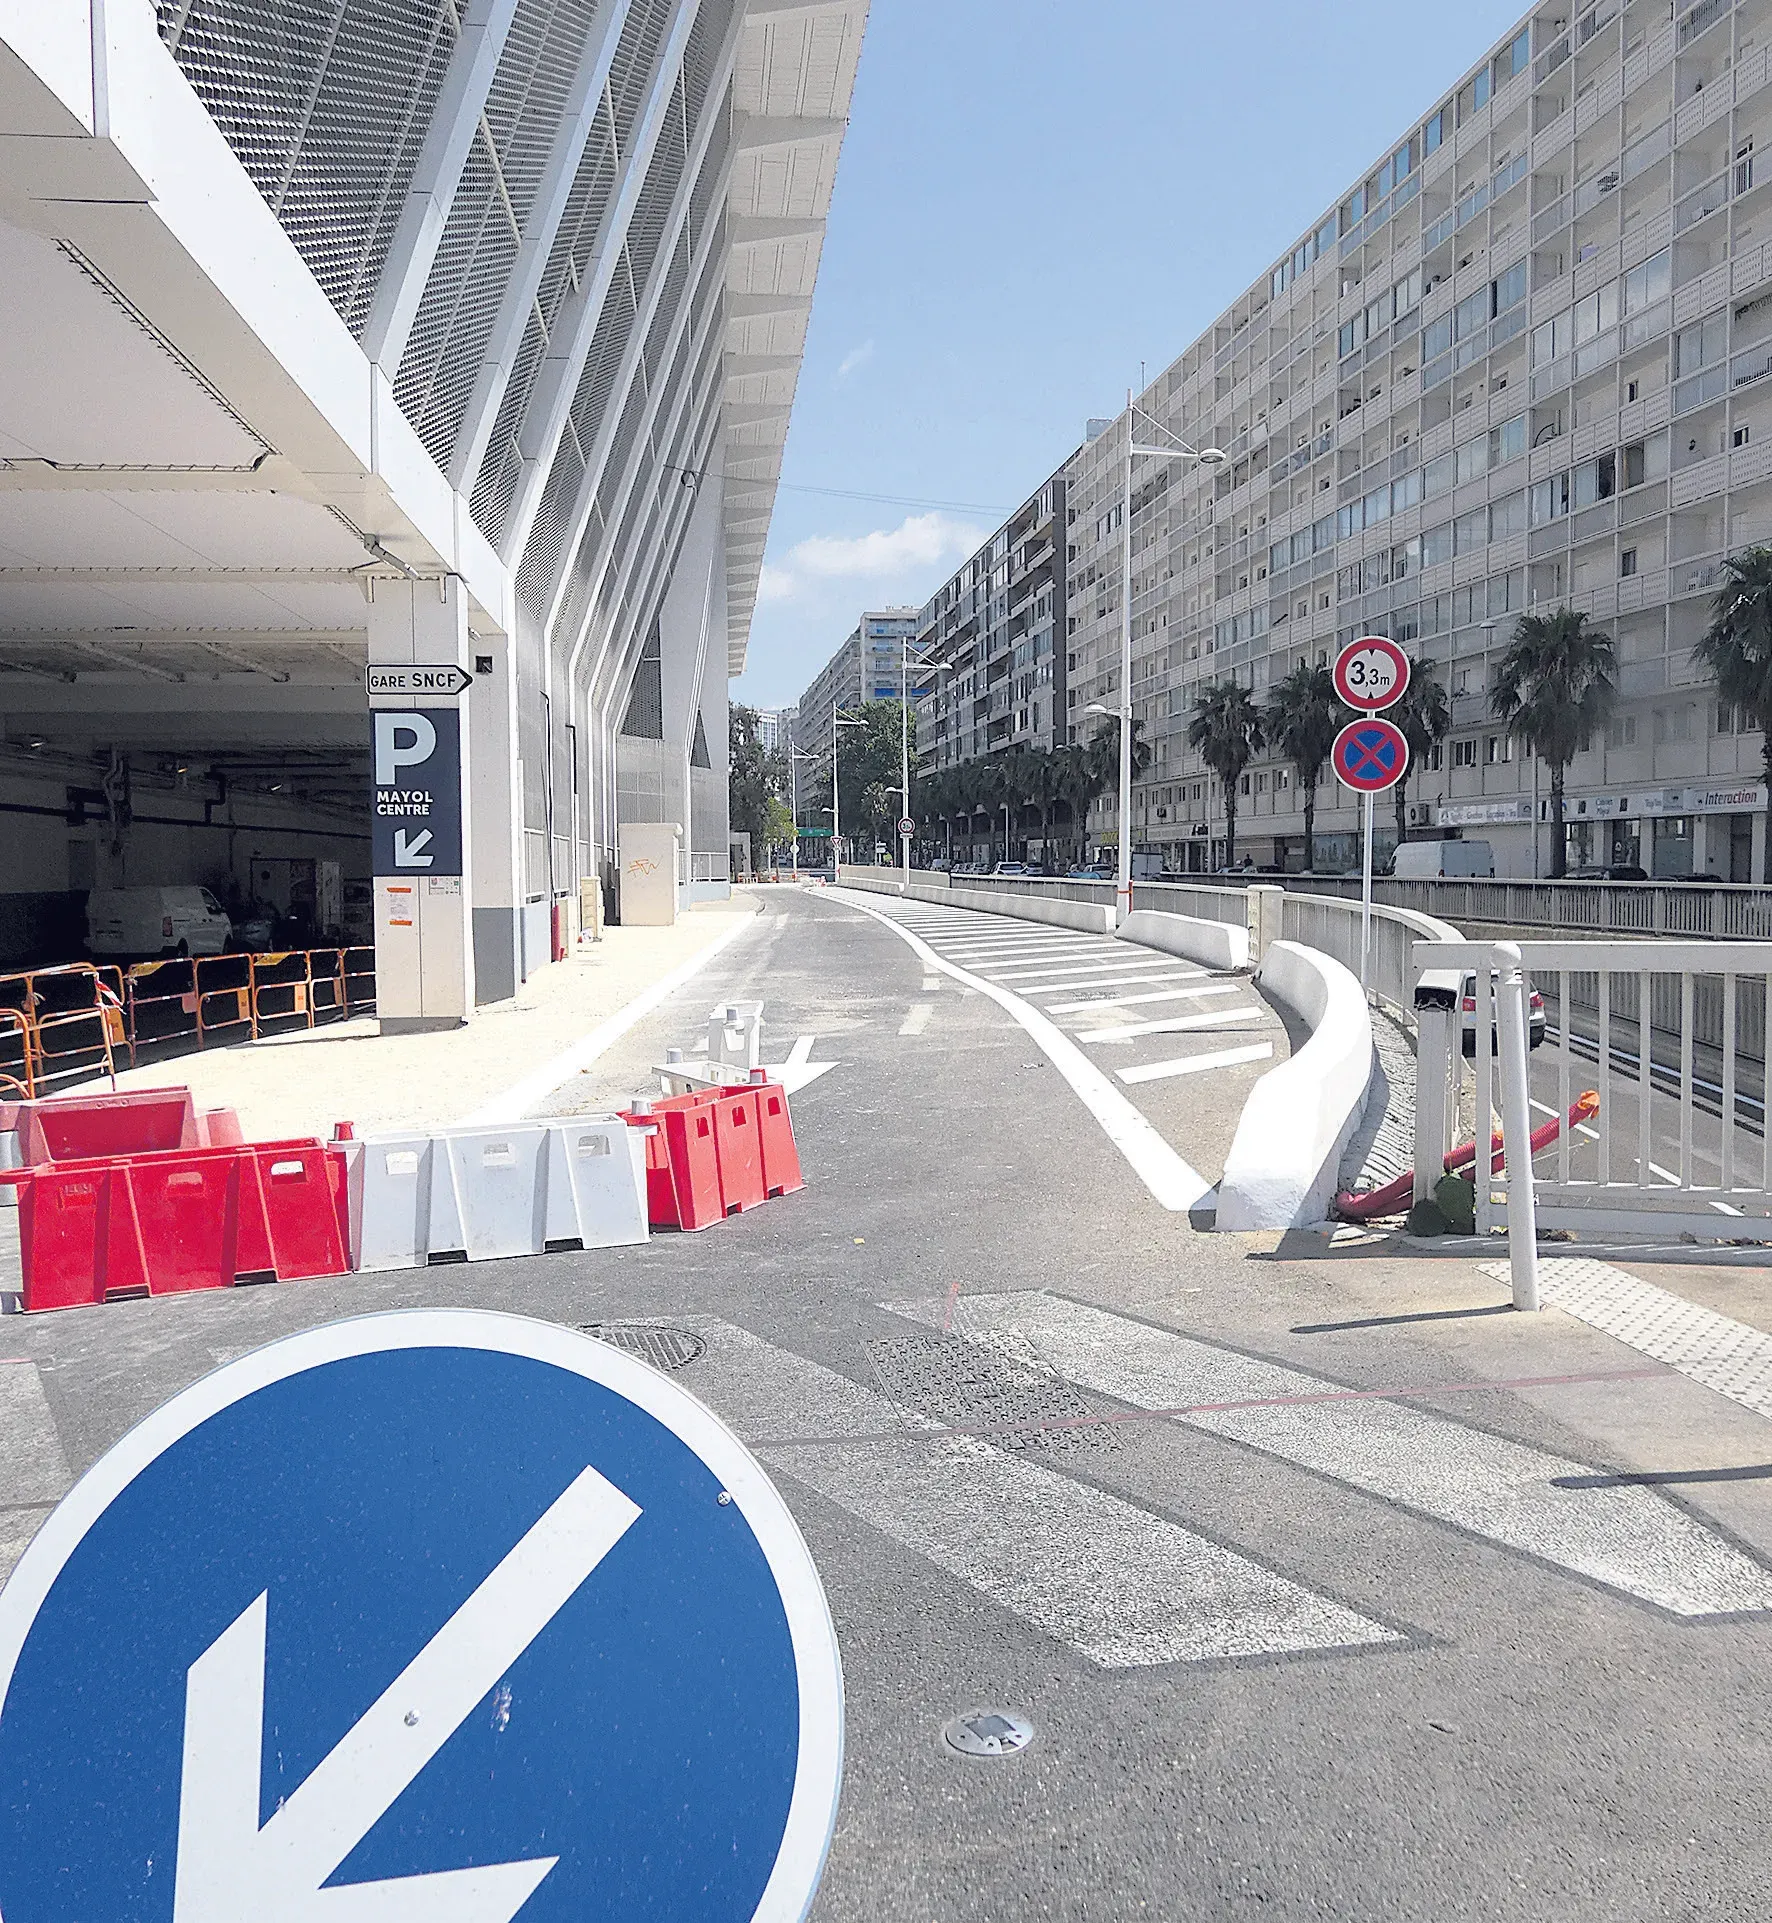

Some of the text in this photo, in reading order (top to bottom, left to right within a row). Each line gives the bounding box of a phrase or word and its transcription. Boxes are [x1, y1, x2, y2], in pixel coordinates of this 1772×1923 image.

[370, 672, 457, 688] GARE SNCF
[374, 712, 437, 785] P
[376, 790, 434, 803] MAYOL
[1704, 788, 1758, 806] Interaction
[376, 803, 430, 816] CENTRE
